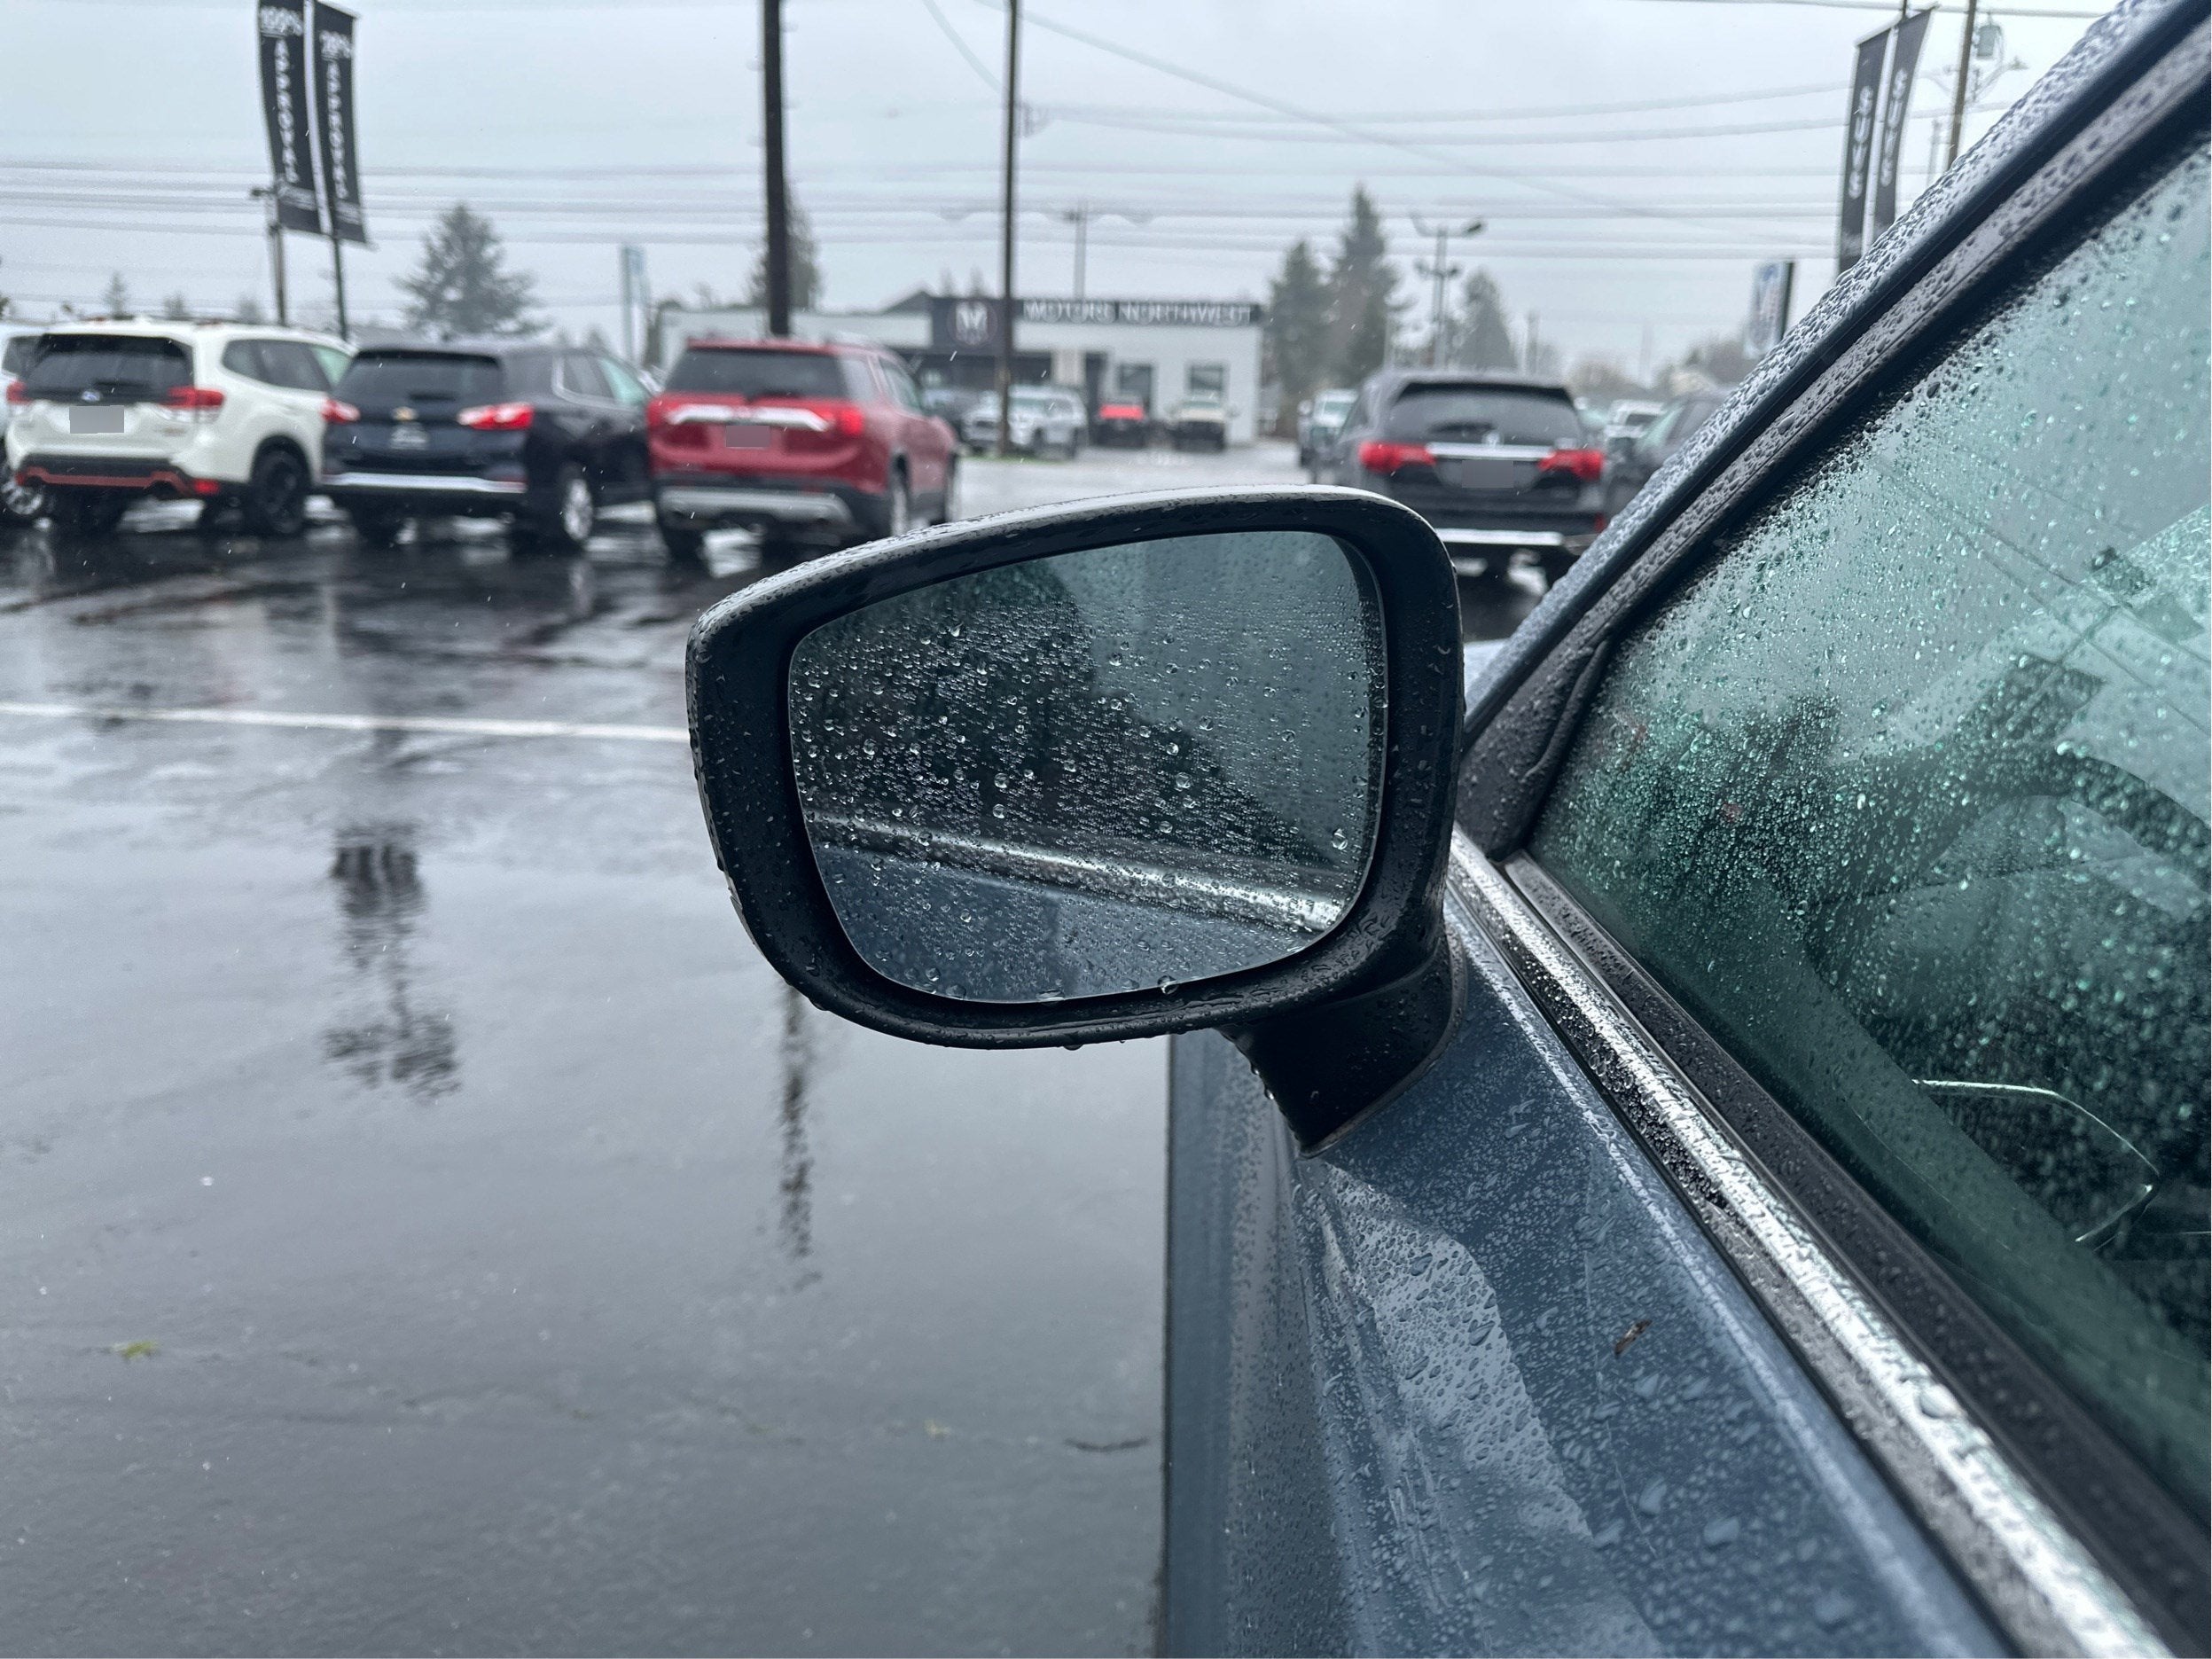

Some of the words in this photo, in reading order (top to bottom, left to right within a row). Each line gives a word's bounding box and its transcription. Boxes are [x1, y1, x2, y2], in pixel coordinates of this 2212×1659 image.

[274, 39, 299, 184] APPROVAL
[326, 61, 348, 198] APPROVAL
[1023, 299, 1115, 324] MOTORS
[1119, 302, 1251, 327] NORTHWEST
